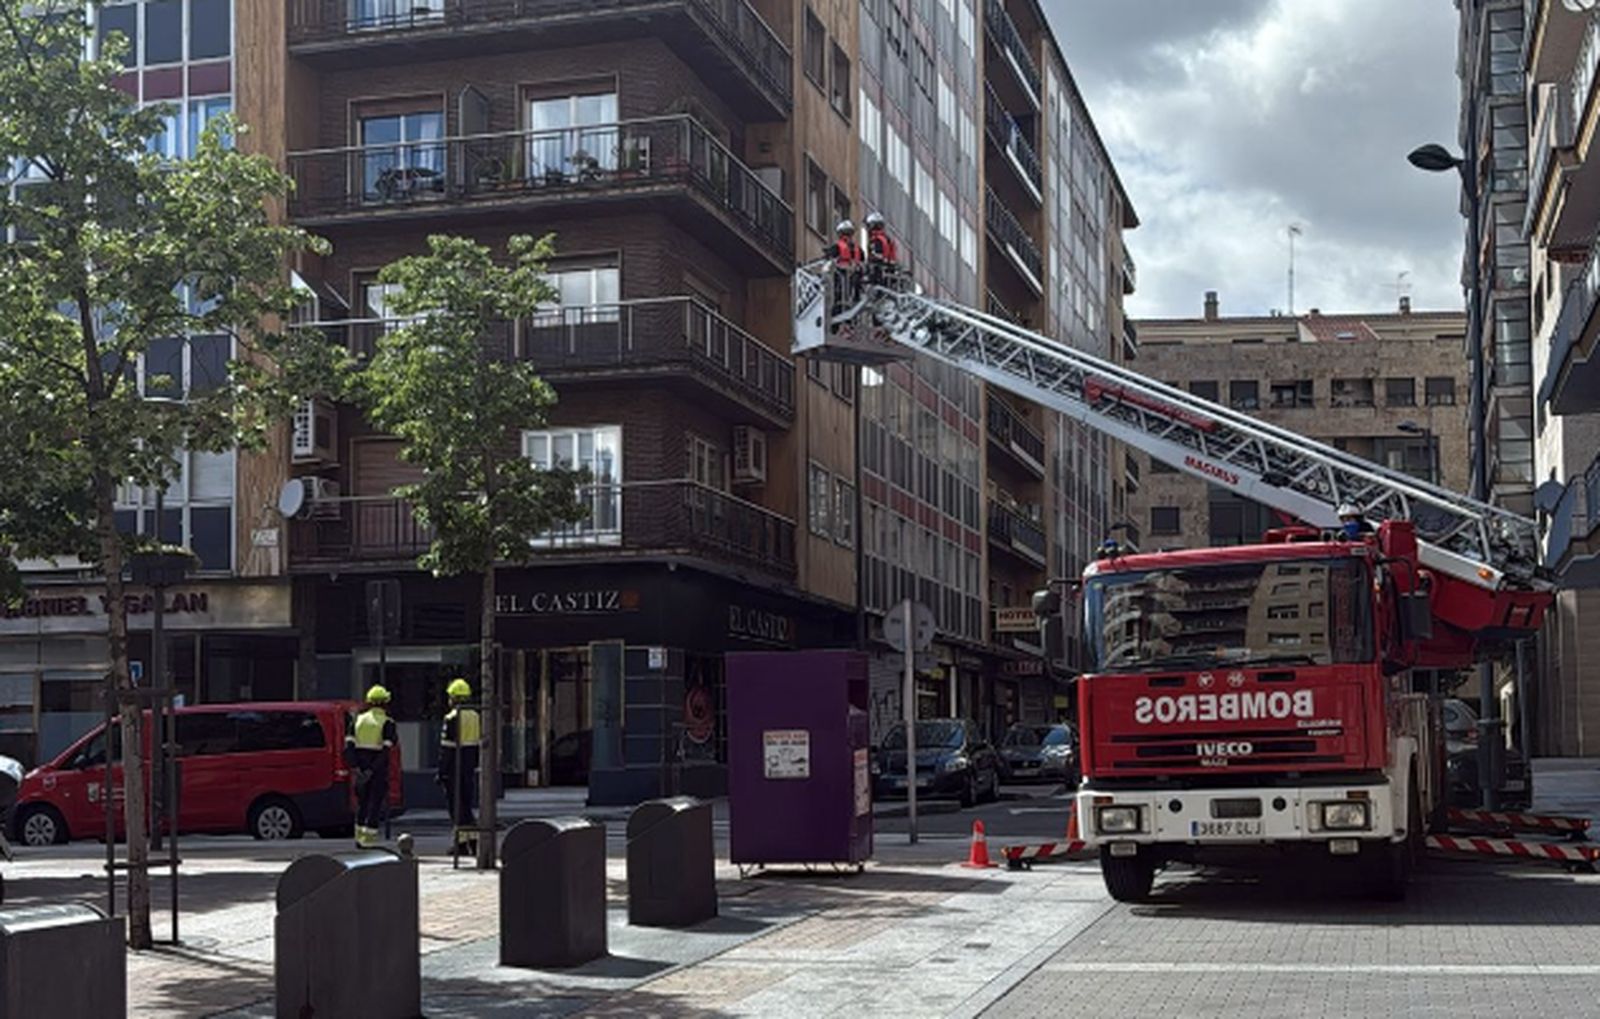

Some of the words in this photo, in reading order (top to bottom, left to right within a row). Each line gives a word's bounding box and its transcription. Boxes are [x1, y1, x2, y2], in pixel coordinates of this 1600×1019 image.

[0, 595, 95, 619] BRIEL
[495, 595, 524, 611] EL
[999, 610, 1034, 620] HOTEL
[1197, 742, 1253, 756] IVECO
